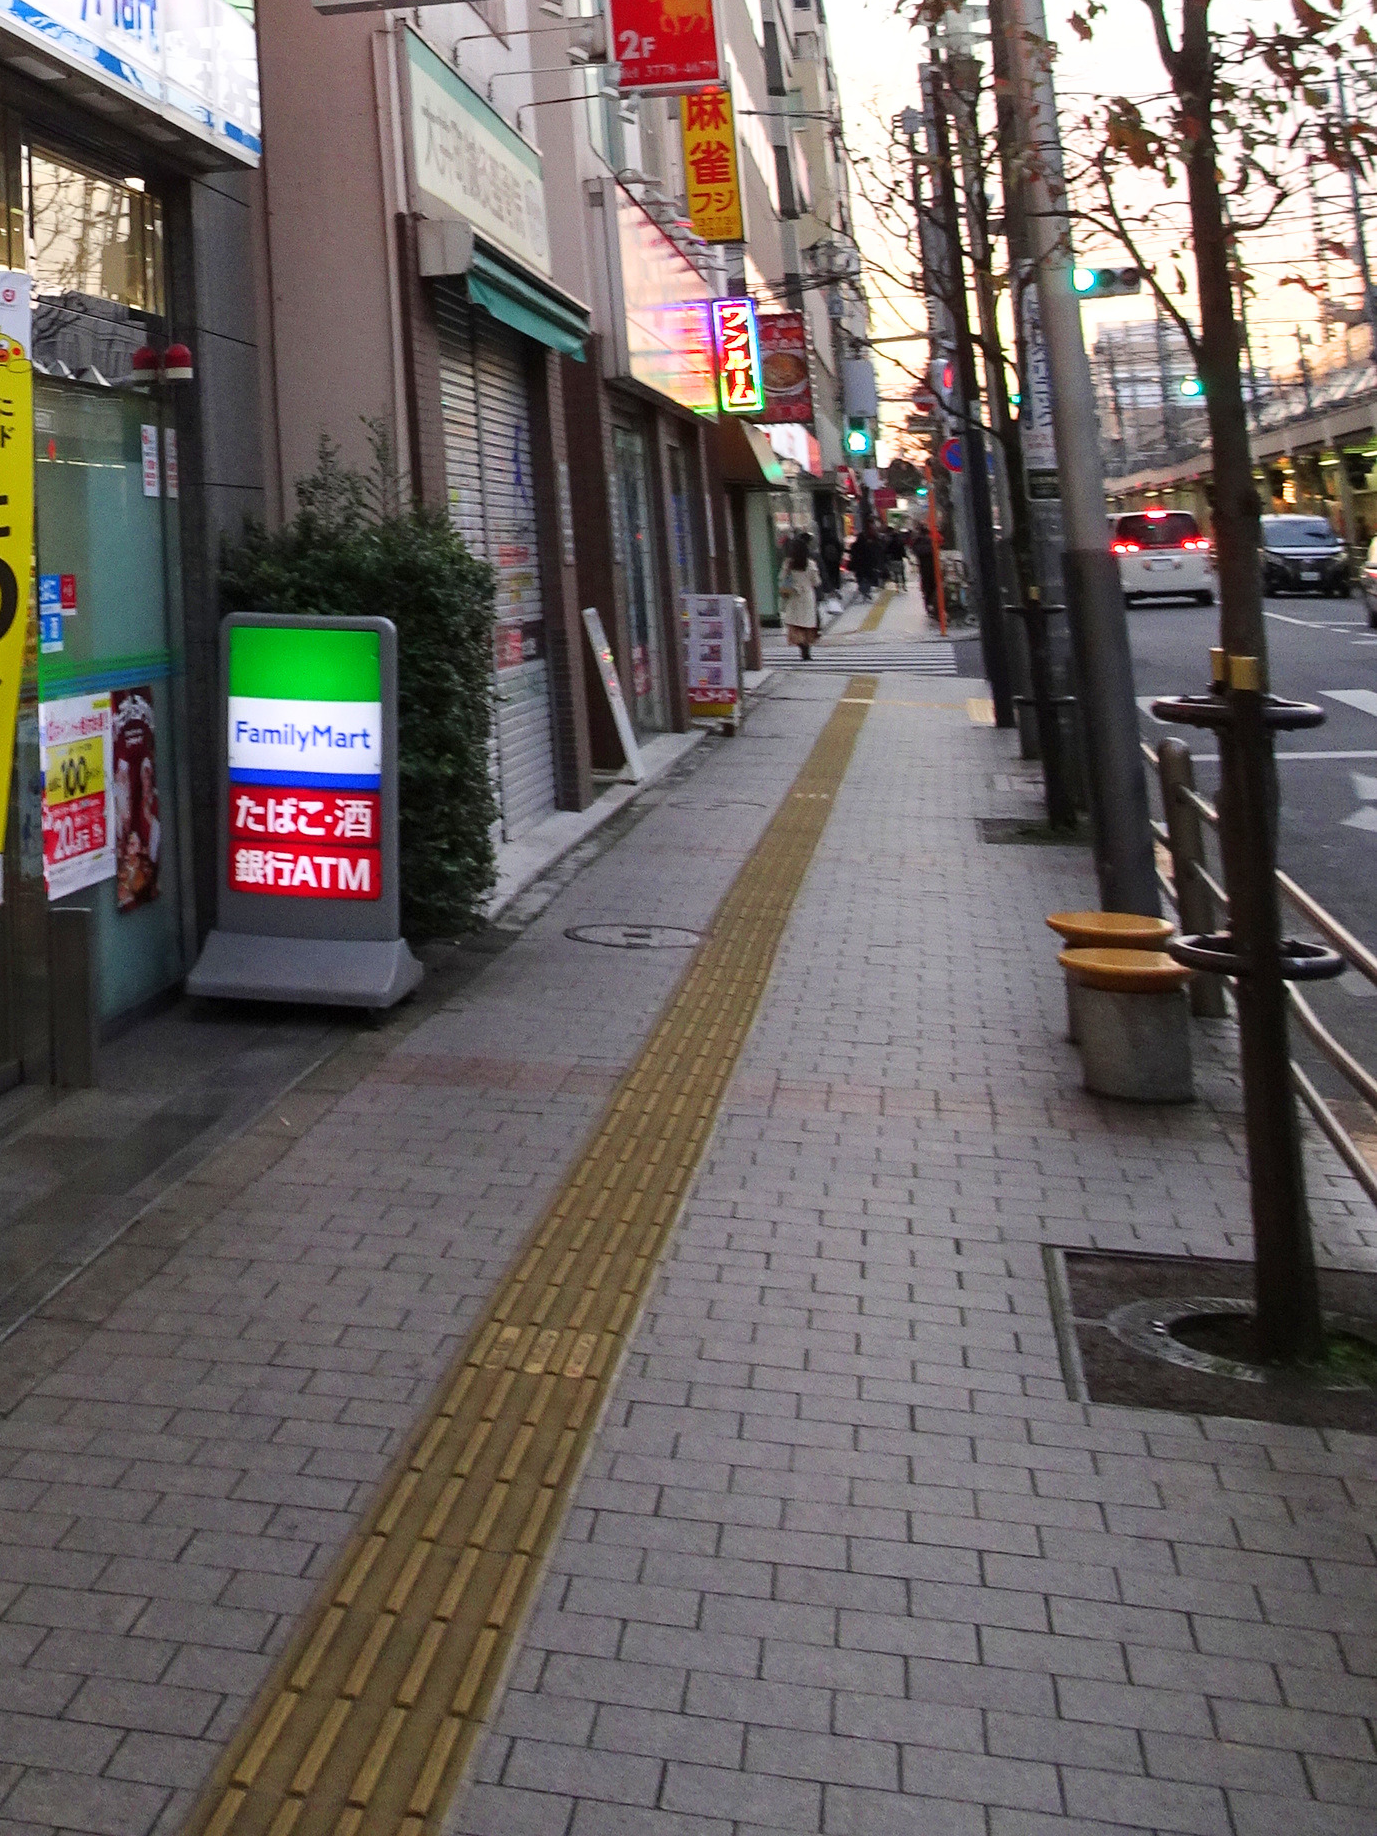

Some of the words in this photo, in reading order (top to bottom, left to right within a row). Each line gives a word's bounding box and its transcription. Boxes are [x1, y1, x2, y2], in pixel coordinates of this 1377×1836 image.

[618, 29, 657, 60] 2F
[686, 94, 732, 185] 麻雀
[691, 189, 734, 214] フジ
[722, 305, 757, 405] ワンルーム
[235, 719, 371, 752] FamilyMart
[235, 848, 372, 892] 銀行ATM
